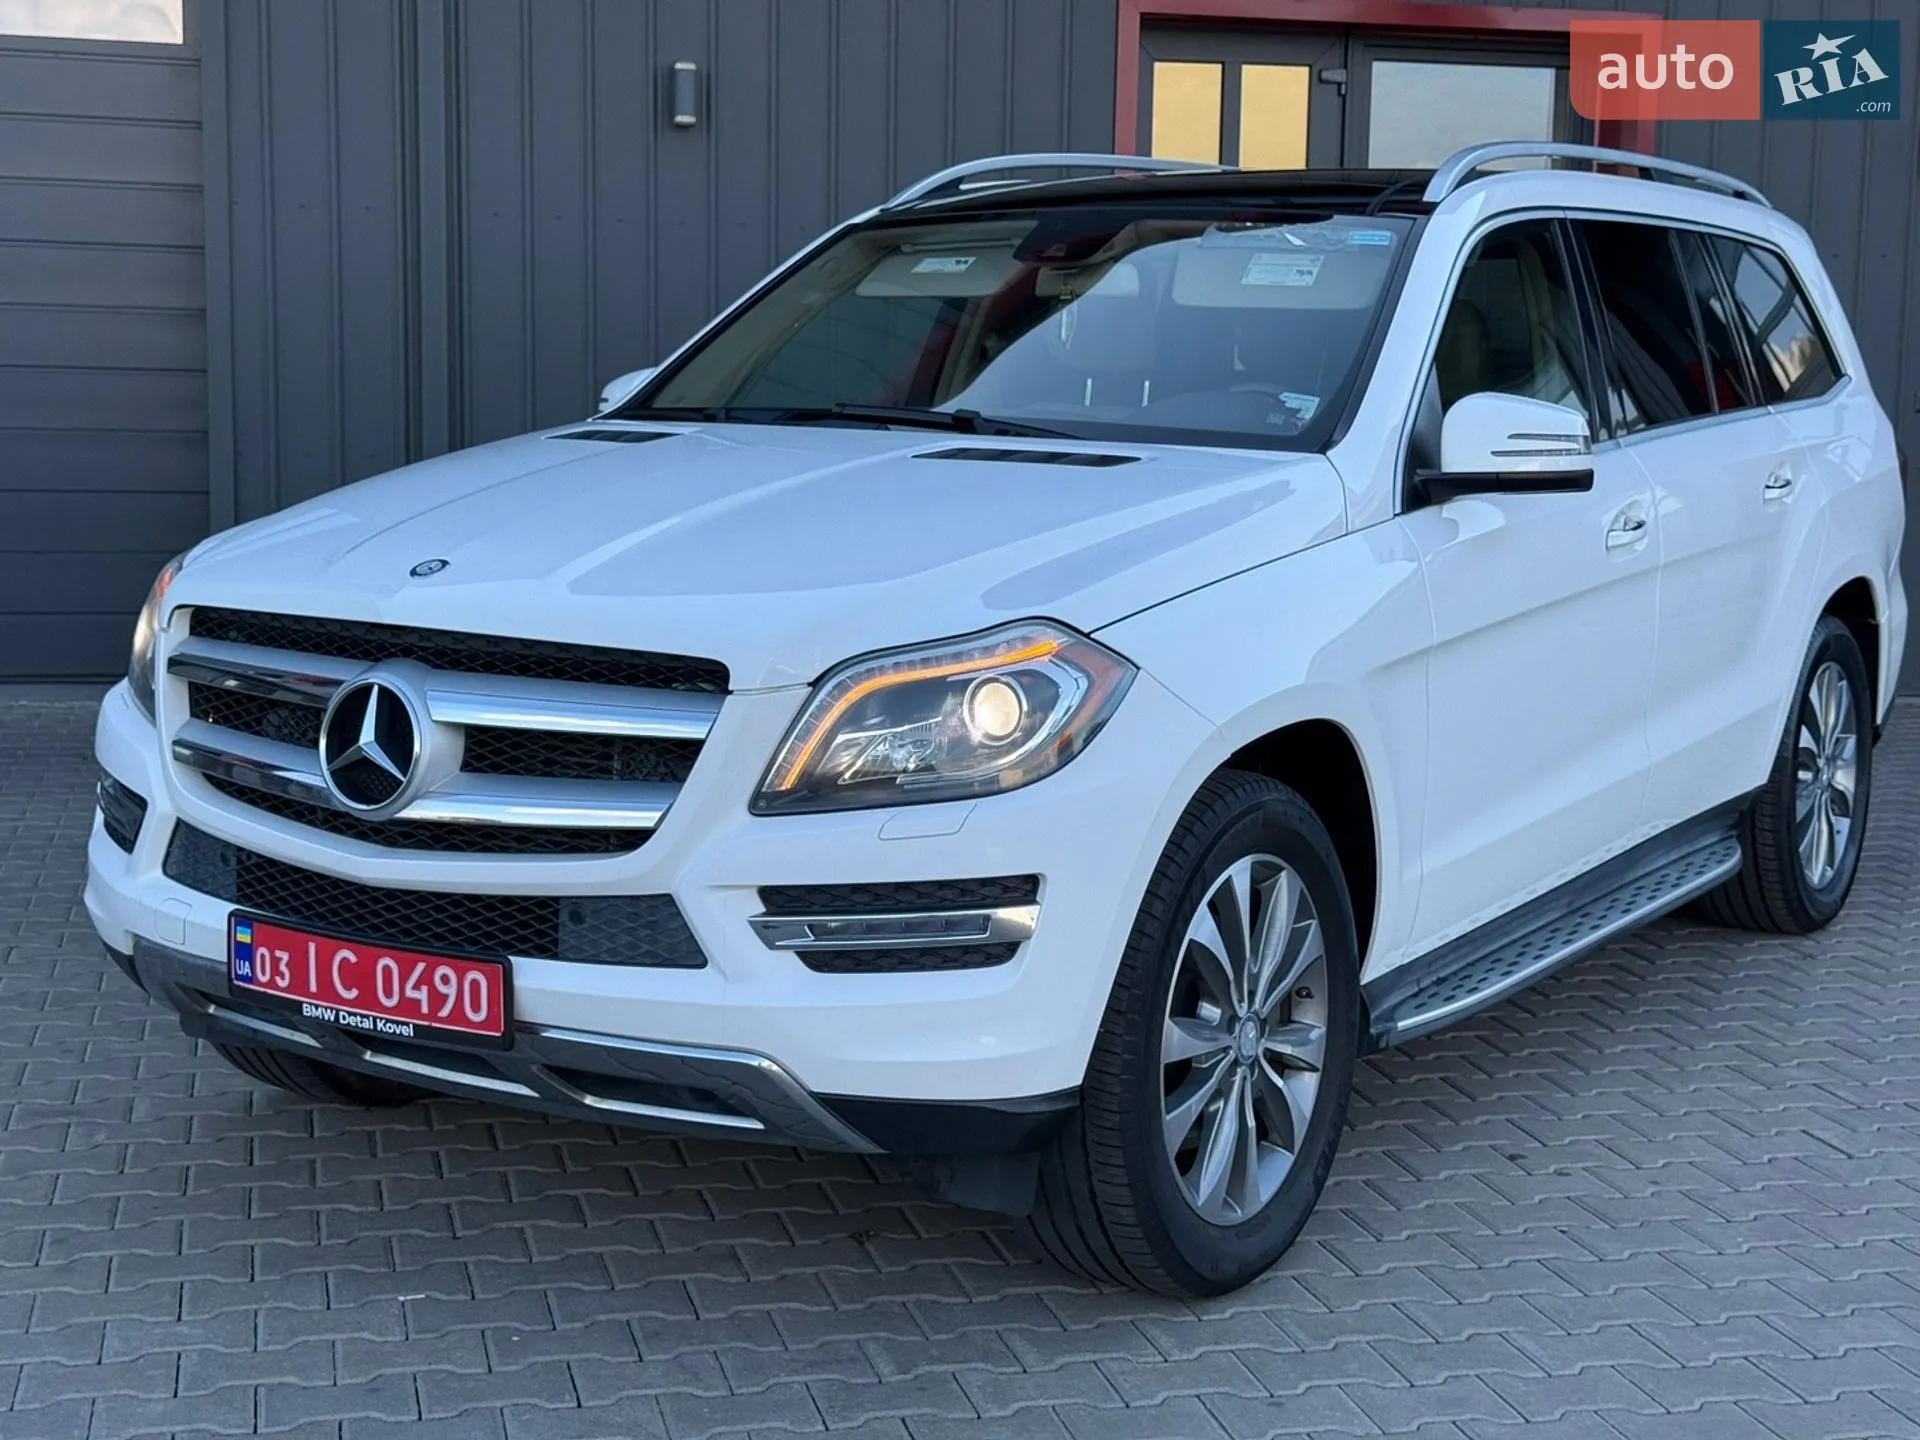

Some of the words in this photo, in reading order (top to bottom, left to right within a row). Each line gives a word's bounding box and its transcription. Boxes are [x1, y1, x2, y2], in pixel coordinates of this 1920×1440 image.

[235, 958, 252, 977] UA
[255, 947, 290, 988] 03
[376, 956, 488, 1023] 0490
[302, 1003, 335, 1022] BMW
[339, 1009, 374, 1030] Detal
[376, 1014, 414, 1037] Kovel
